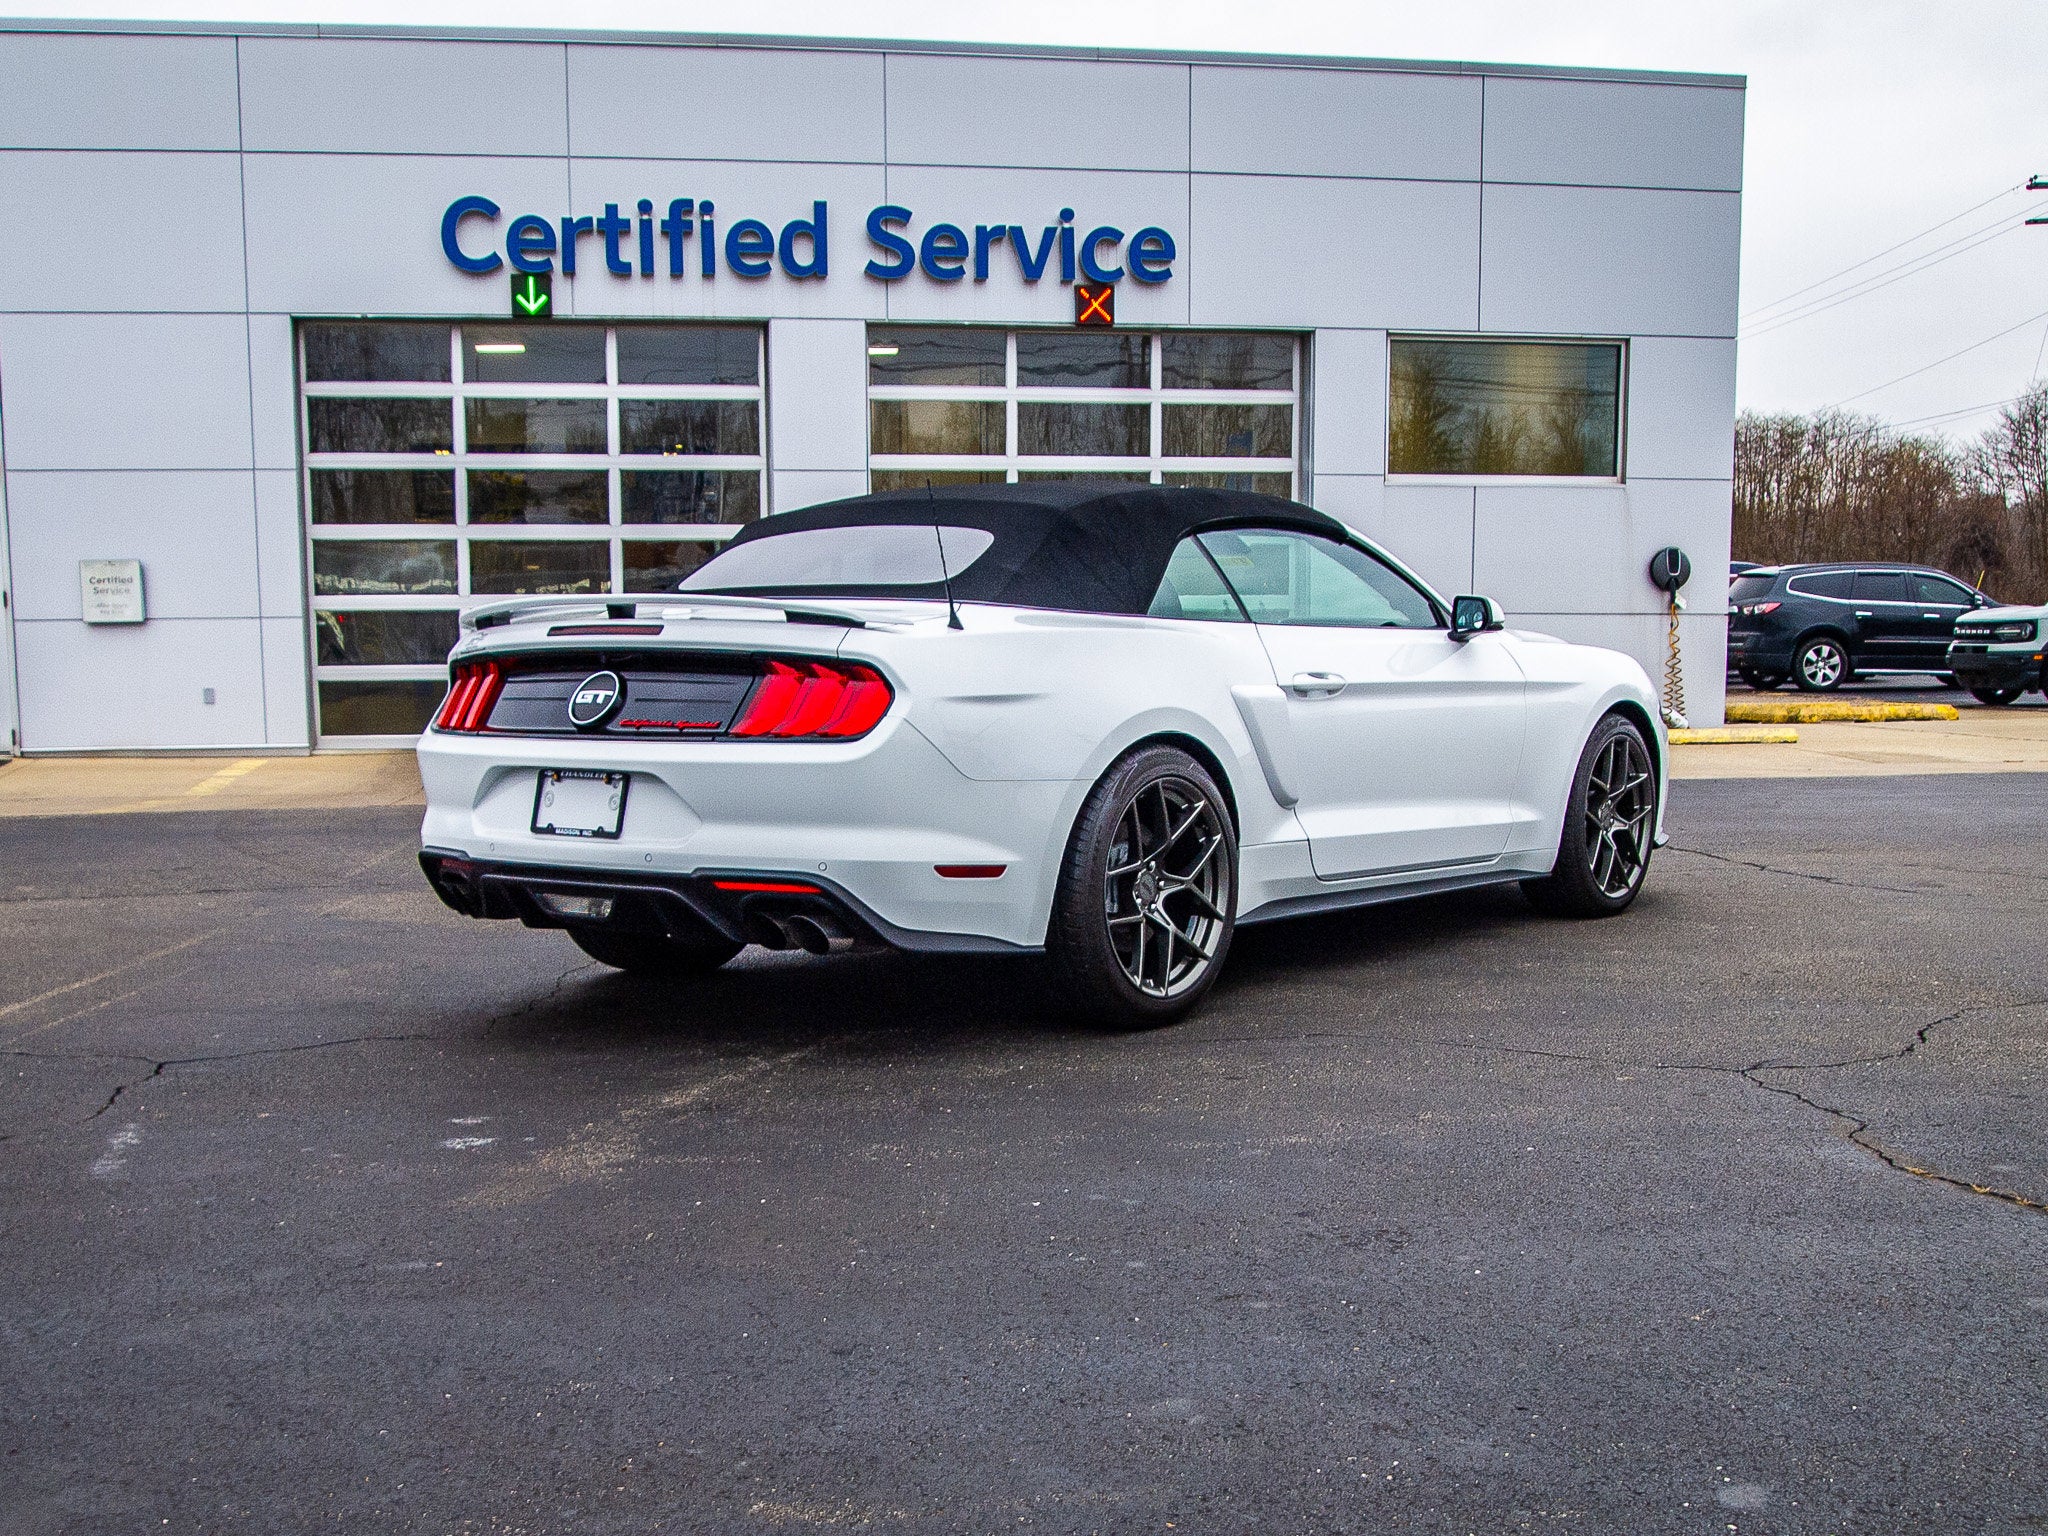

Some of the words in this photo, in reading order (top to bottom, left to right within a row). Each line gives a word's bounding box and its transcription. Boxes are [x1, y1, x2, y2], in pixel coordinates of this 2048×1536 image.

[441, 197, 828, 279] Certified
[865, 206, 1176, 283] Service
[89, 576, 133, 585] Certified
[93, 587, 130, 596] Service
[575, 689, 614, 704] GT
[560, 770, 608, 779] CHANDLER
